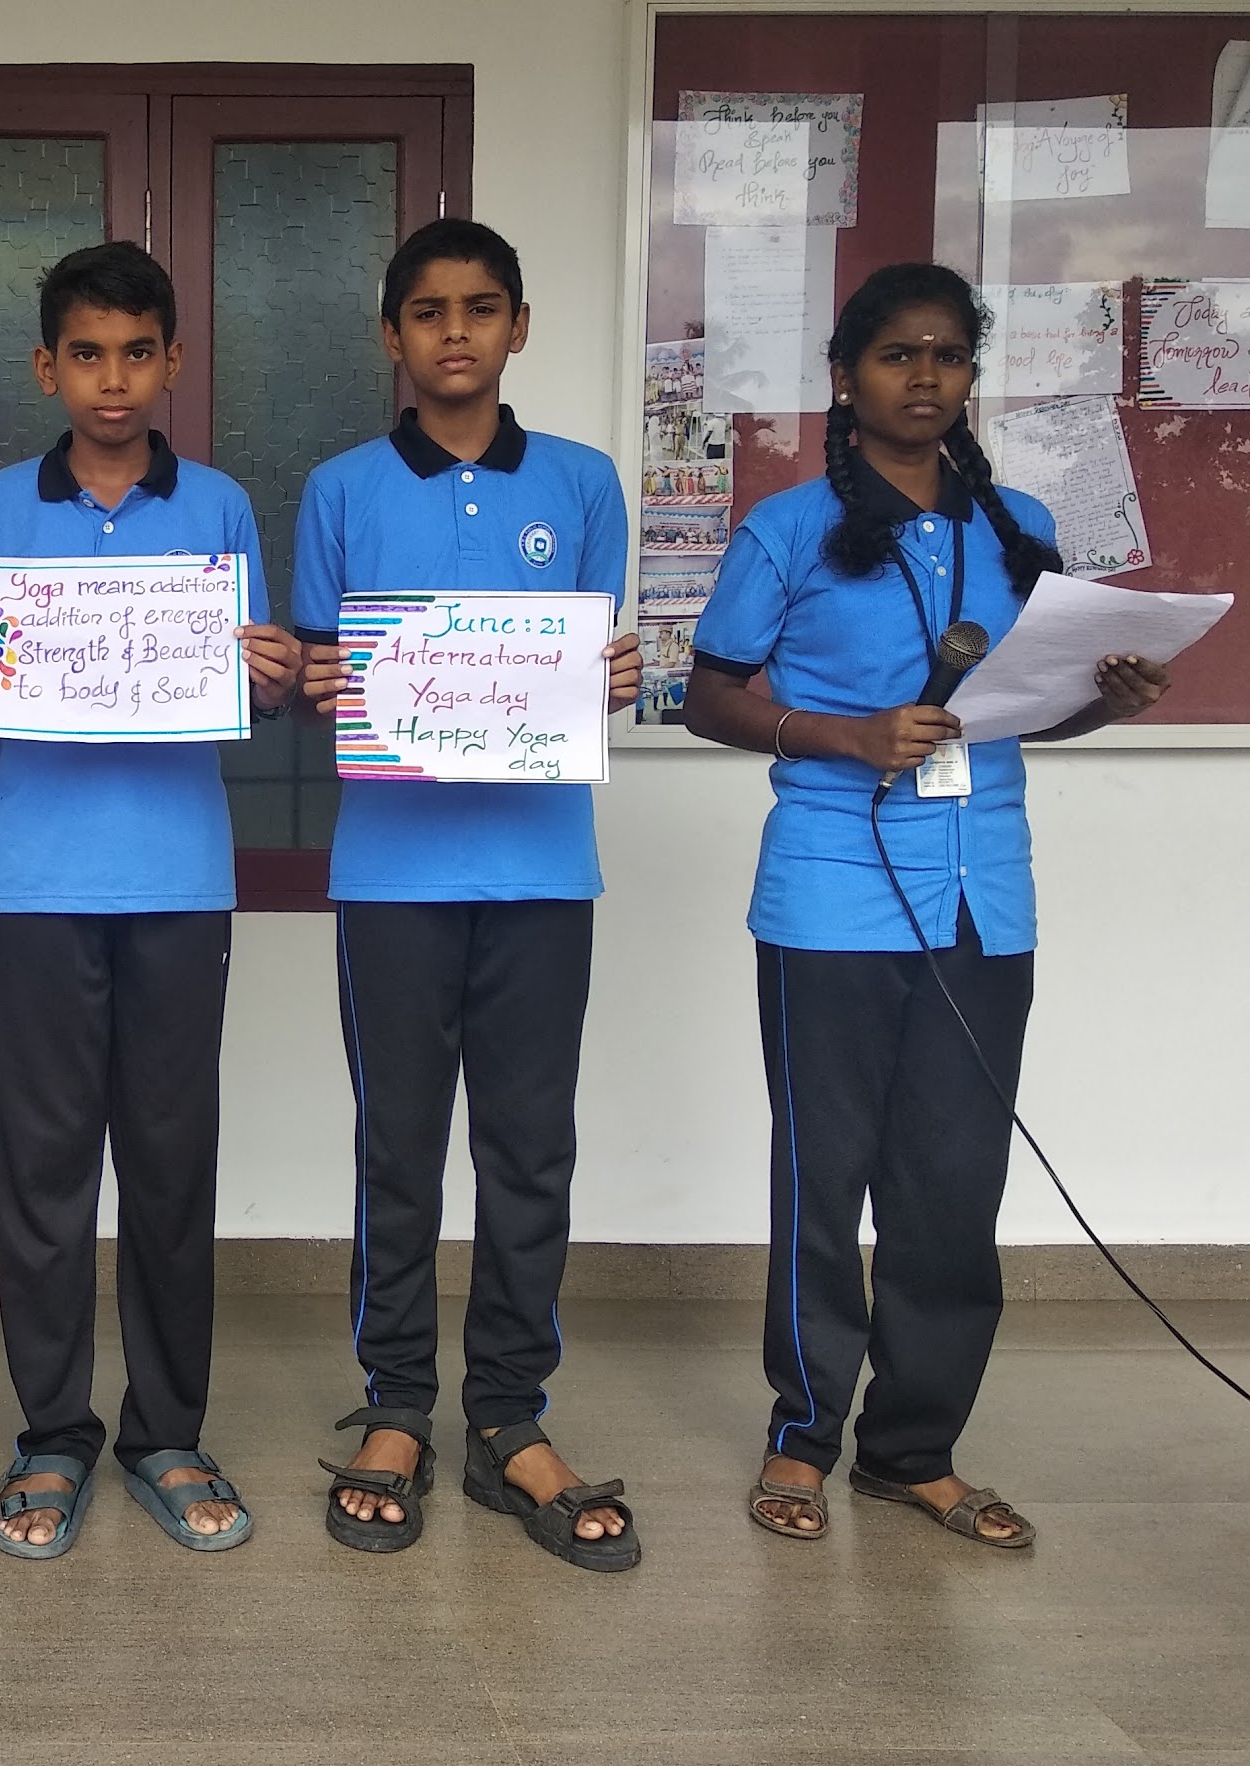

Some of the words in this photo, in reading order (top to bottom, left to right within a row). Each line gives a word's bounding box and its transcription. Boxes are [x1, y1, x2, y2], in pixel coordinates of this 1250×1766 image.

[702, 104, 754, 135] Think
[770, 106, 816, 132] before
[817, 110, 841, 132] you
[743, 130, 792, 150] Speak
[1097, 123, 1114, 157] of
[699, 149, 744, 182] Read
[752, 151, 797, 176] before
[802, 156, 837, 181] you
[1172, 295, 1229, 335] Today
[1046, 349, 1073, 378] life
[1149, 331, 1240, 370] Tomorrow
[0, 572, 64, 609] Yoga
[77, 578, 146, 596] means
[20, 606, 102, 628] addition
[109, 605, 136, 639] of
[143, 605, 229, 635] energy,
[423, 603, 516, 638] June
[539, 617, 567, 635] 21
[18, 634, 110, 674] Strength
[121, 639, 134, 674] &
[134, 633, 231, 675] Beauty
[372, 636, 563, 676] International
[13, 674, 43, 701] to
[58, 672, 120, 709] body
[130, 680, 142, 717] &
[151, 676, 209, 704] Soul
[408, 677, 473, 713] Yoga
[479, 680, 529, 716] day
[388, 716, 490, 756] Happy
[506, 722, 570, 754] Yoga
[508, 748, 562, 780] day
